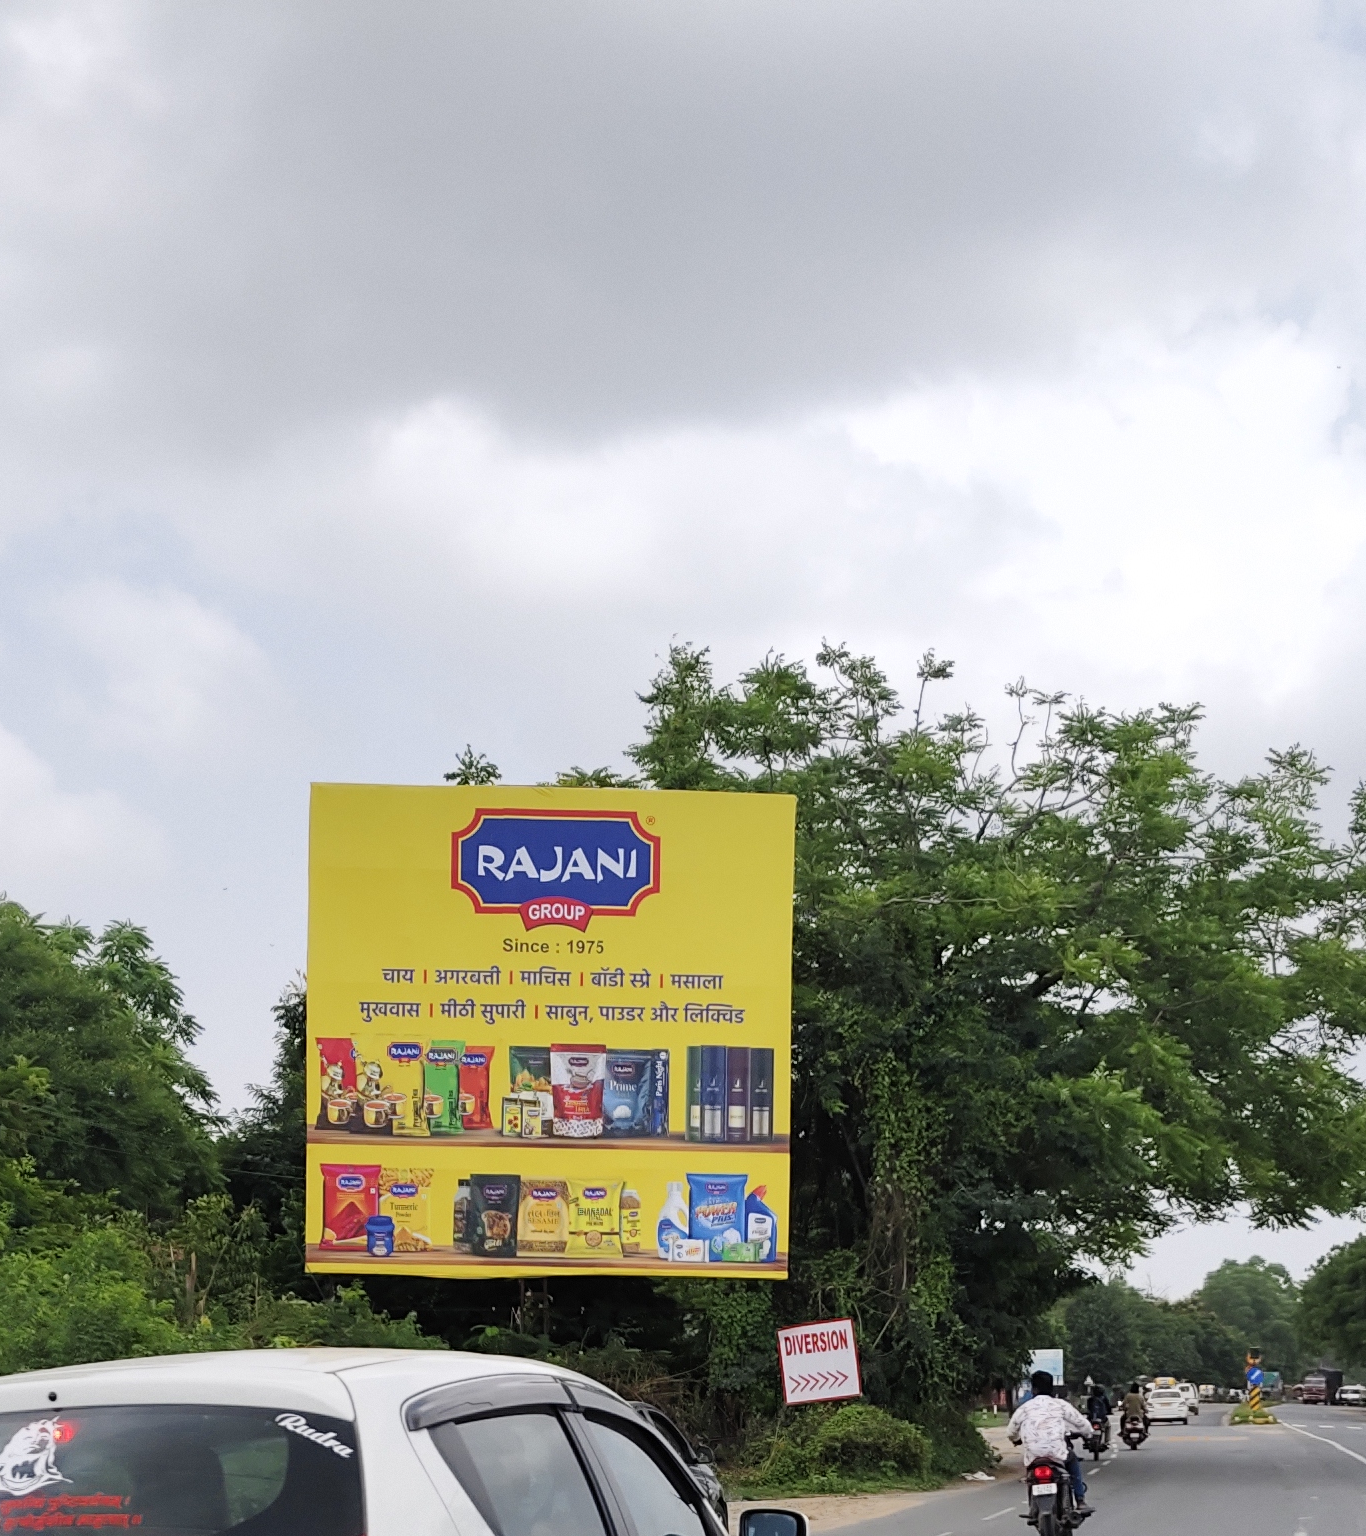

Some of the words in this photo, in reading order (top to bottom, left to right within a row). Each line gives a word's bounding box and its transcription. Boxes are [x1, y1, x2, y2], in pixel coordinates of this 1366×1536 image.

[477, 845, 637, 883] RAJANI
[528, 903, 585, 921] GROUP
[502, 938, 550, 953] Since
[566, 940, 604, 954] 1975
[381, 968, 415, 983] चाय
[435, 966, 502, 985] अगरबत्ती
[520, 966, 572, 986] माचिस
[590, 967, 625, 987] बॉडी
[629, 968, 652, 988] स्प्रे
[670, 974, 724, 989] मसाला
[359, 1002, 421, 1022] मुखवास
[440, 998, 476, 1018] मीठी
[480, 999, 526, 1025] सुपारी
[545, 1005, 593, 1026] साबुन,
[598, 1006, 645, 1022] पाउडर
[650, 1001, 679, 1022] और
[683, 1003, 745, 1024] लिक्विड
[390, 1047, 420, 1056] RAJANI
[428, 1051, 455, 1060] RAJANI
[609, 1080, 637, 1092] Prime
[784, 1329, 848, 1356] DIVERSION
[275, 1413, 354, 1458] Rudra
